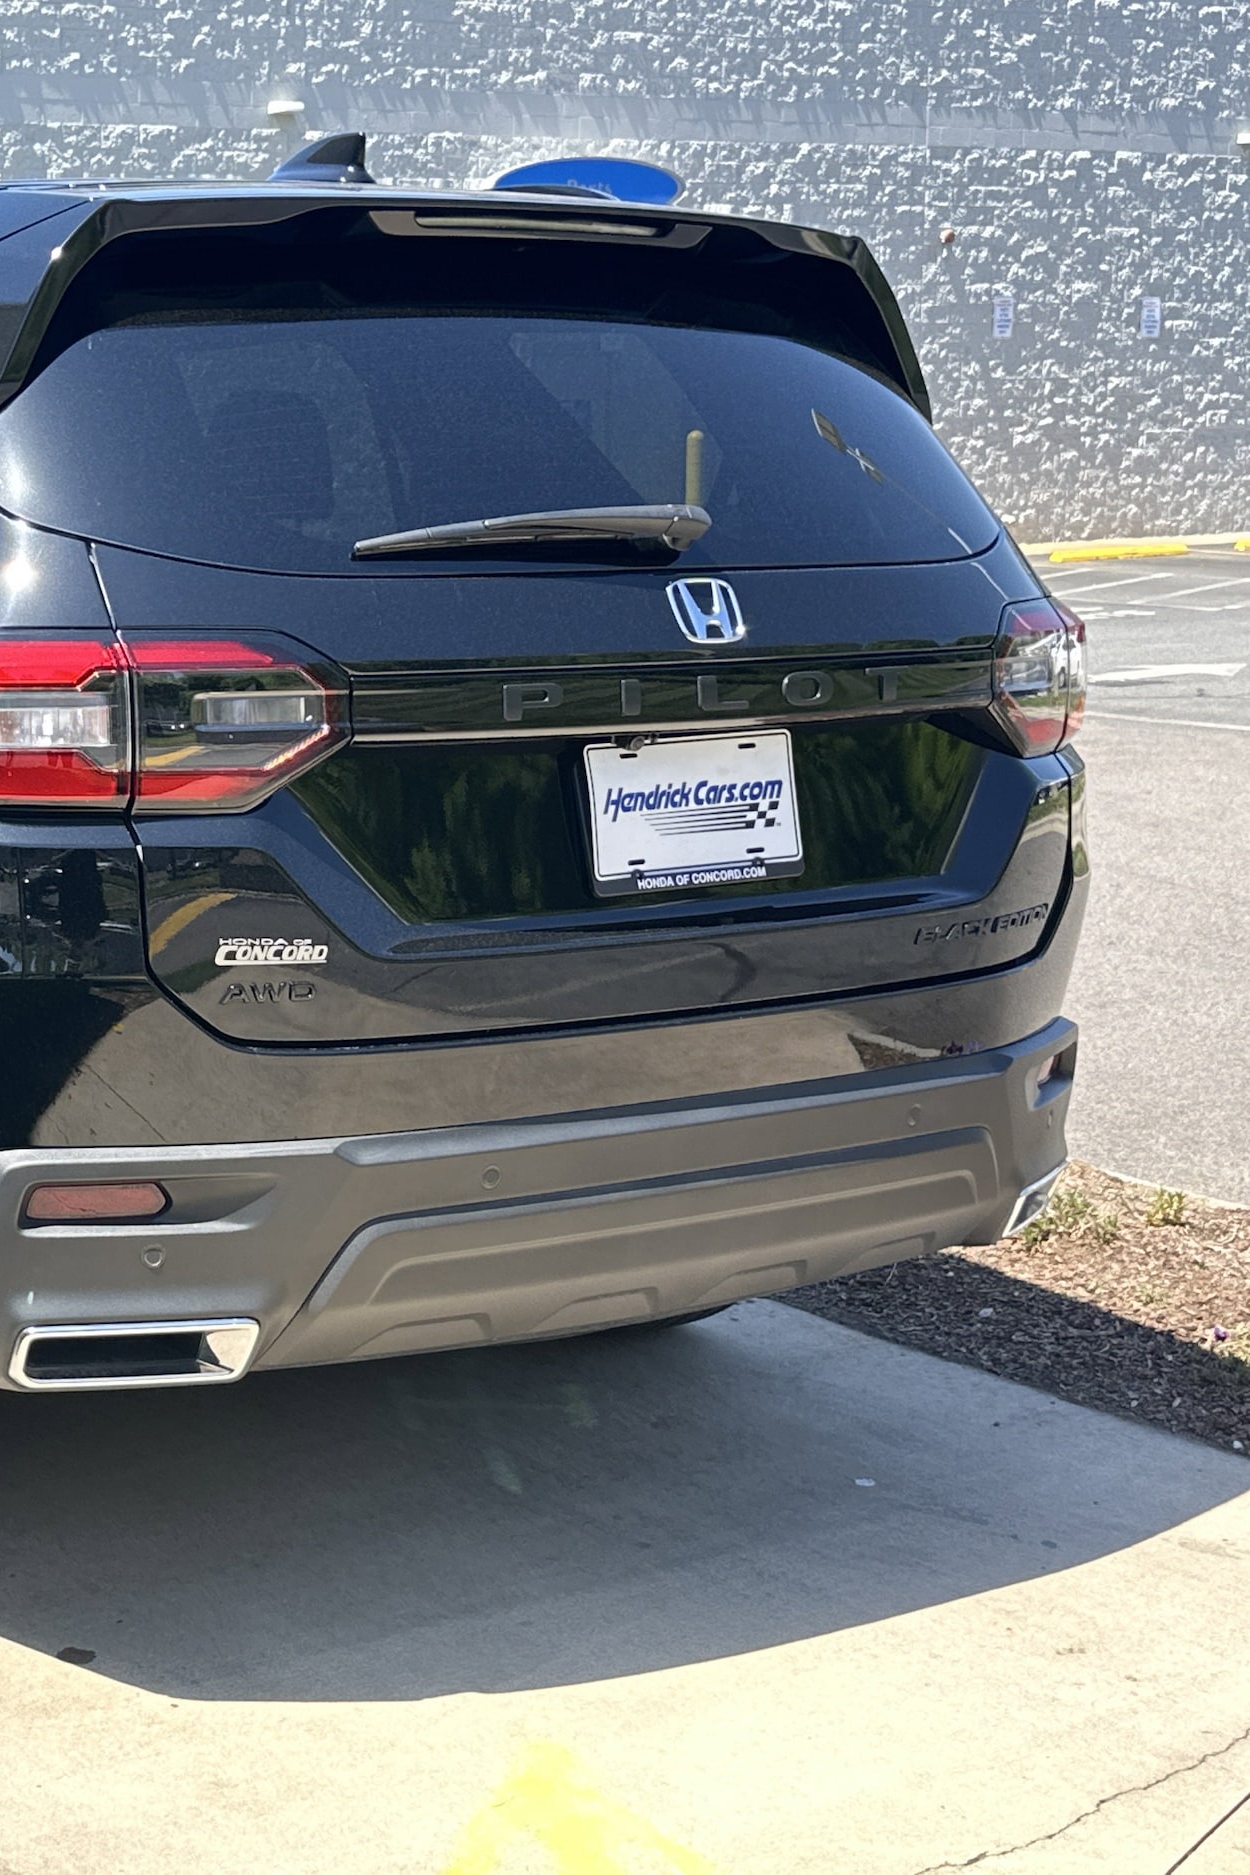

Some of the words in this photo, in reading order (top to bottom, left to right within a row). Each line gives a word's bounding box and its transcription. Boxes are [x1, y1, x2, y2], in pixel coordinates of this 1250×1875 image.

[502, 666, 910, 722] PILOT
[637, 877, 675, 890] HONDA
[675, 873, 690, 886] OF
[691, 866, 767, 884] CONCORD.COM
[215, 945, 328, 966] CONCORD
[218, 980, 318, 1005] AWD
